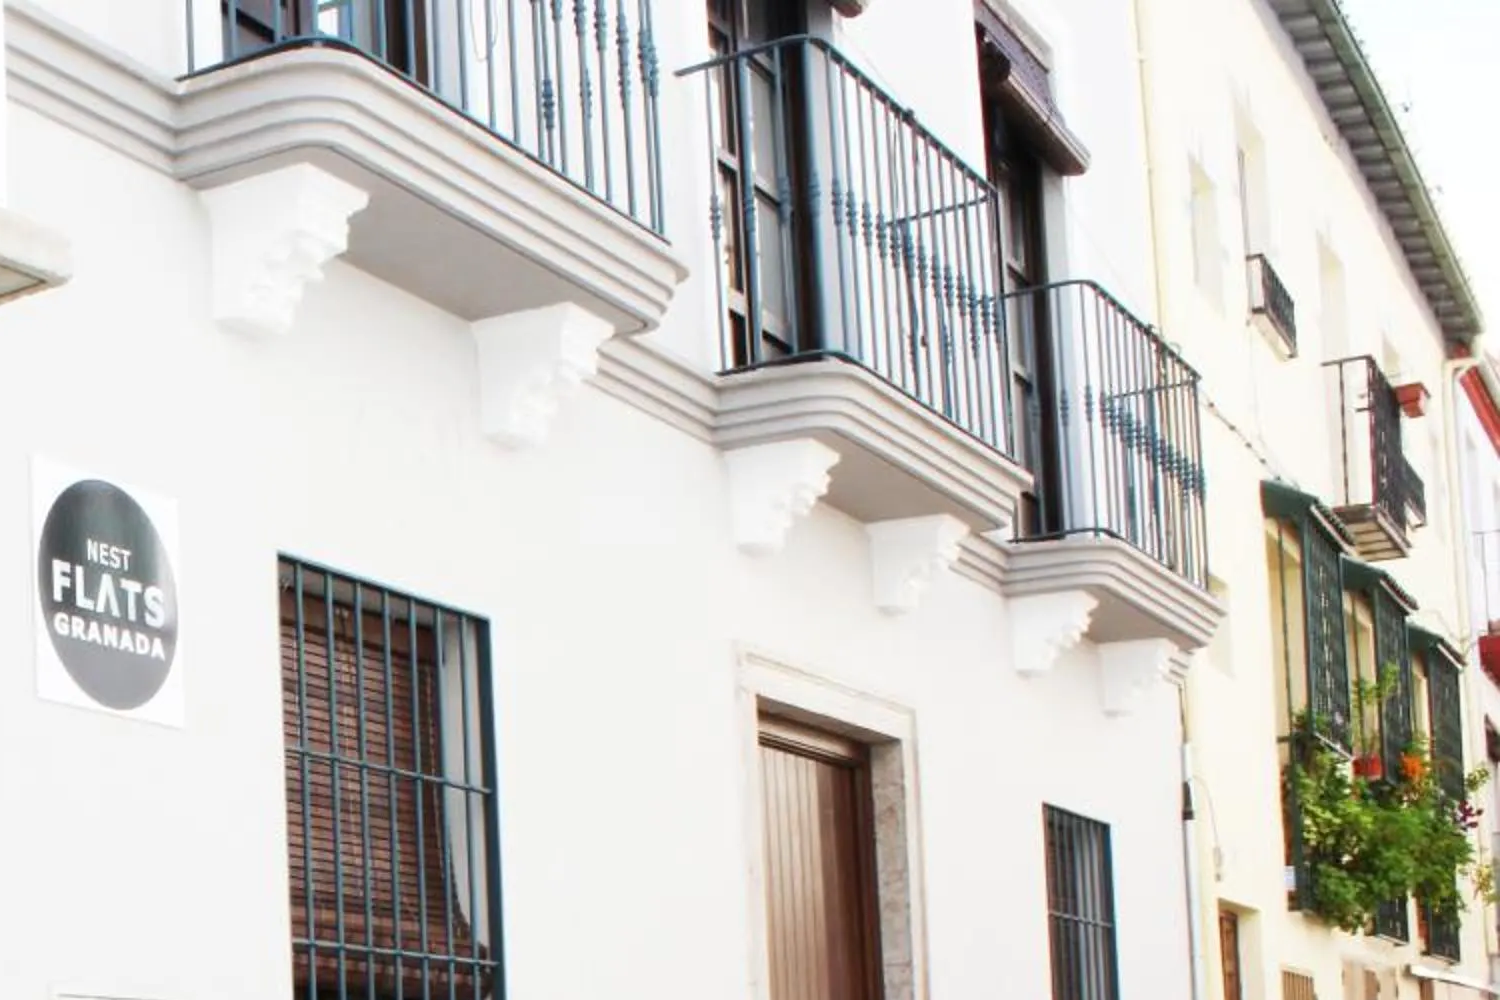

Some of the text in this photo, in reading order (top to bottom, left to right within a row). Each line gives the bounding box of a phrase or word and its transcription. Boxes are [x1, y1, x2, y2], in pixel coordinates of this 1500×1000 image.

[86, 539, 132, 571] NEST
[52, 559, 165, 629] FLATS
[53, 611, 165, 661] GRANADA
